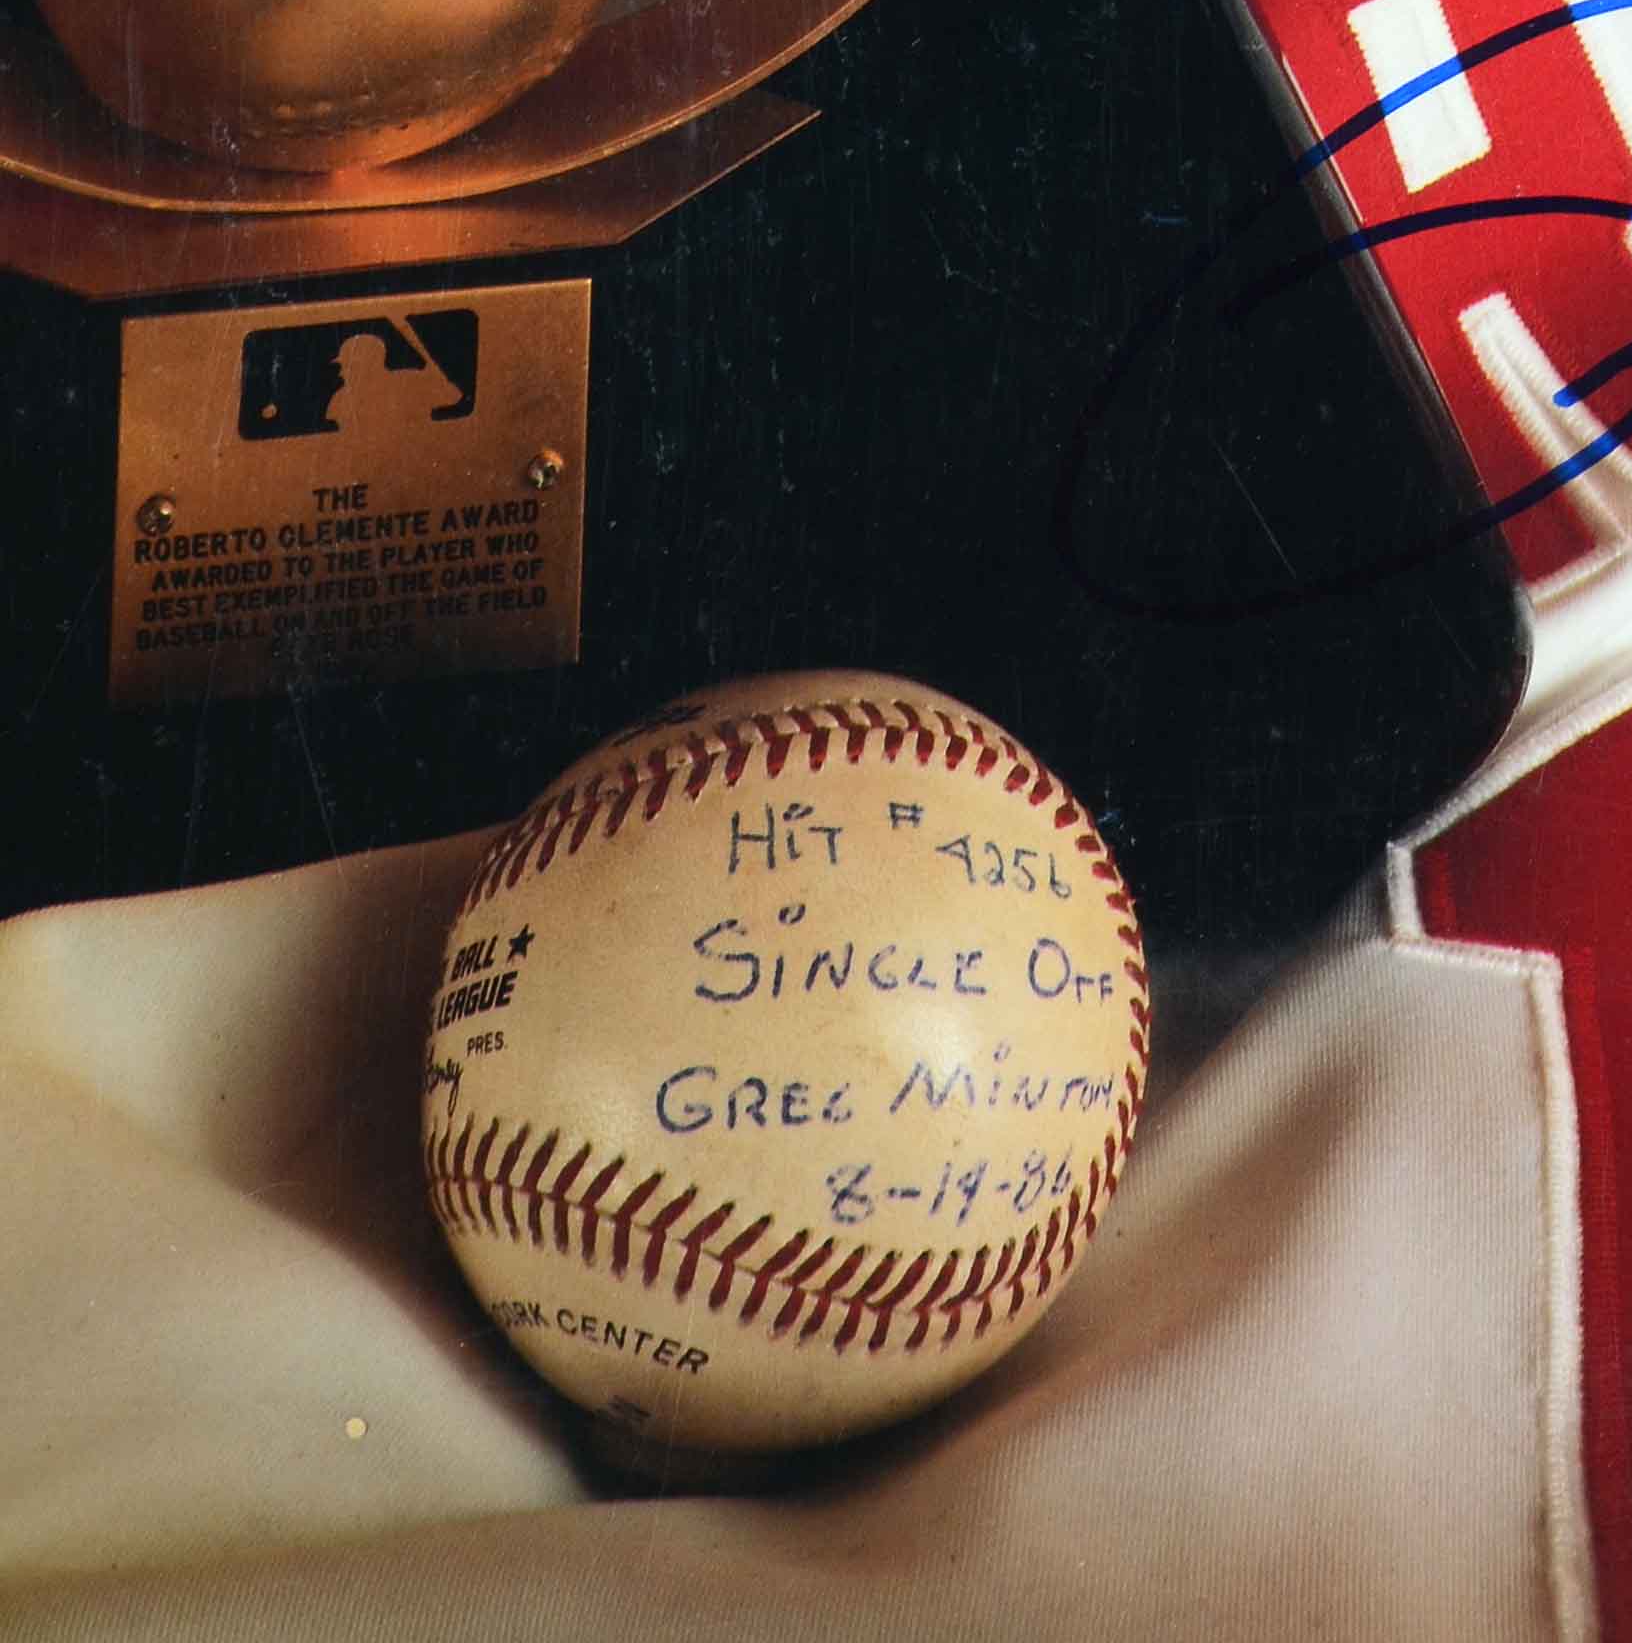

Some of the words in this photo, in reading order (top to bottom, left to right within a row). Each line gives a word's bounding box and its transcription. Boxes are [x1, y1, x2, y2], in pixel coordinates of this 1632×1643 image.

[313, 483, 369, 513] THE
[134, 527, 268, 564] ROBERTO
[278, 508, 431, 550] CLEMENTE
[441, 498, 540, 533] AWARD
[152, 557, 273, 593] AWARDED
[283, 555, 314, 578] TO
[326, 548, 371, 575] THE
[379, 537, 477, 570] PLAYER
[484, 530, 540, 559] WHO
[141, 593, 209, 624] BEST
[386, 570, 433, 597] THE
[441, 560, 506, 590] GAME
[513, 557, 546, 584] OF
[477, 586, 549, 612] FIELD
[450, 933, 499, 984] BALL
[436, 969, 518, 1031] LEAGUE
[556, 1307, 711, 1376] CENTER
